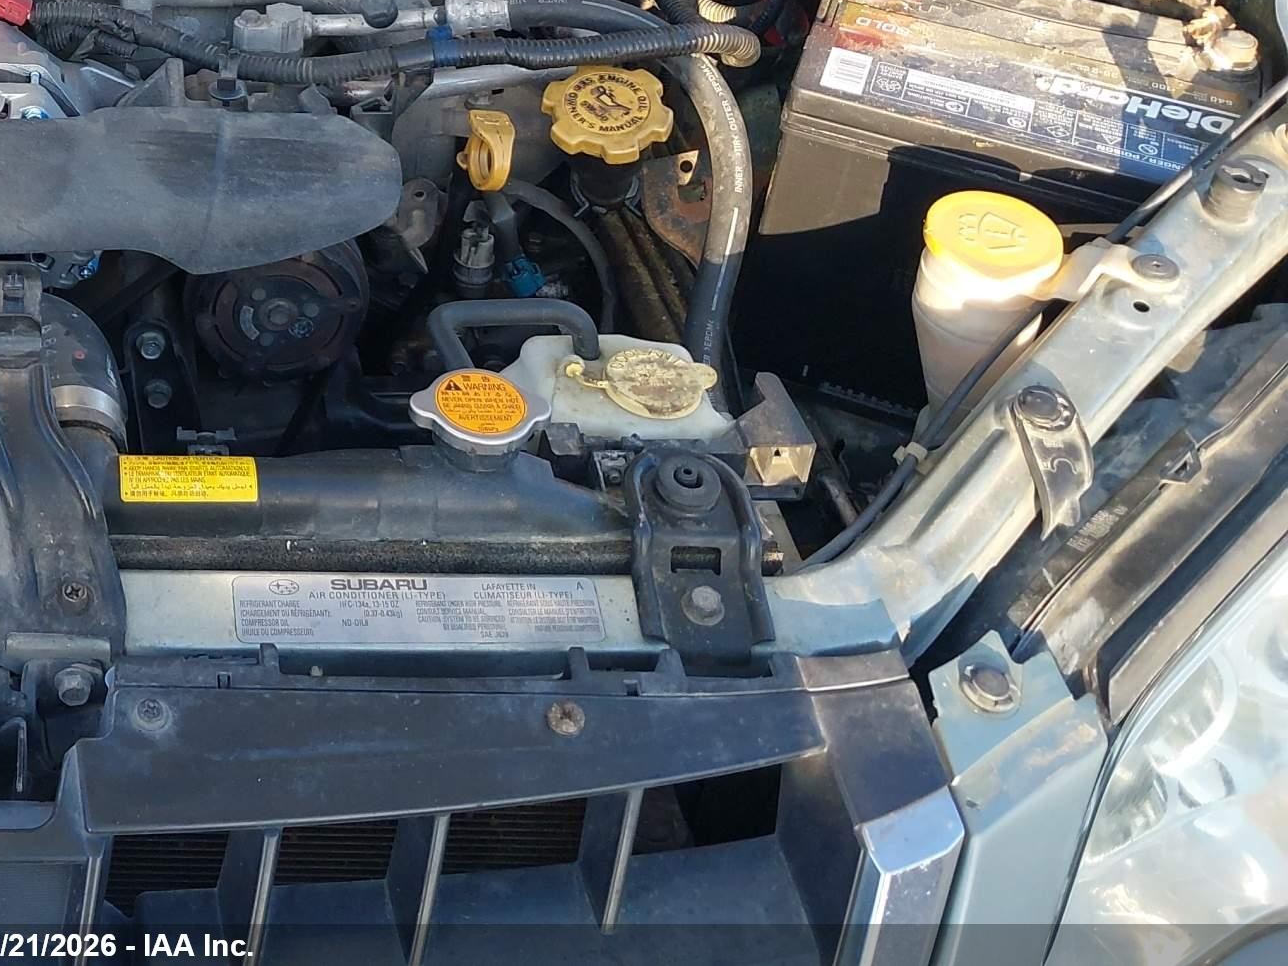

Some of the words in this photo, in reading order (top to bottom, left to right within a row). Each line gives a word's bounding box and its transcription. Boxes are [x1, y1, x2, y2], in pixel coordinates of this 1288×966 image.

[598, 73, 642, 95] ENGINE
[637, 95, 649, 112] OIL
[1049, 76, 1235, 135] DieHard
[721, 98, 738, 131] OUTER
[598, 114, 643, 132] MANUAL
[734, 166, 744, 194] INNER
[463, 382, 507, 391] WARNING
[330, 578, 428, 591] SUBARU
[481, 583, 525, 591] LAFAYETTE
[525, 583, 536, 591] IN
[575, 581, 584, 590] A
[308, 592, 327, 600] AIR
[328, 591, 399, 600] CONDITIONER
[400, 591, 447, 601] (LI-TYPE)
[473, 591, 533, 600] CLIMATISEUR
[239, 600, 278, 608] REFRIGERANT
[277, 600, 301, 608] CHARGE
[389, 601, 400, 609] OZ
[281, 609, 291, 618] DU
[241, 618, 279, 627] COMPRESSOR
[279, 618, 290, 627] OIL
